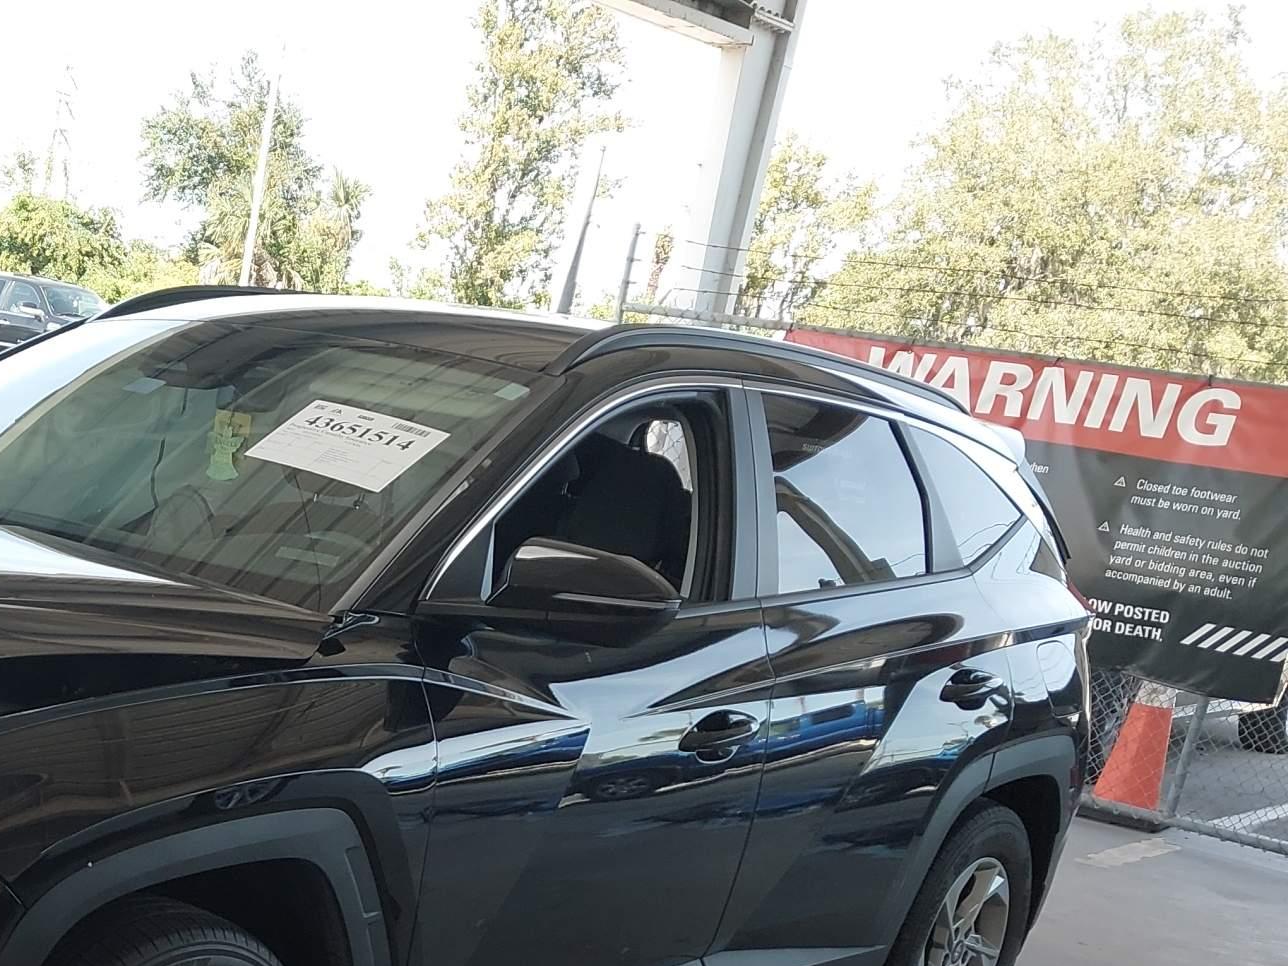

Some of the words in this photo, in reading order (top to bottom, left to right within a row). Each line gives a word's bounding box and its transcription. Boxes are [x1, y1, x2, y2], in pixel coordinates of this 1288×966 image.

[305, 416, 415, 450] 43651514
[1031, 462, 1049, 474] hen
[1136, 479, 1171, 494] Closed
[1172, 485, 1188, 496] toe
[1190, 487, 1238, 503] footwear
[1131, 495, 1156, 507] must
[1158, 498, 1170, 509] be
[1172, 502, 1199, 513] worn
[1201, 506, 1214, 516] on
[1216, 508, 1241, 520] yard.
[1119, 523, 1152, 538] Health
[1153, 531, 1173, 542] and
[1173, 534, 1206, 550] safety
[1206, 540, 1233, 552] rules
[1234, 543, 1248, 555] do
[1250, 547, 1269, 559] not
[1109, 555, 1133, 566] yard
[1134, 559, 1147, 569] or
[1148, 559, 1186, 577] bidding
[1189, 568, 1215, 582] area,
[1218, 574, 1245, 586] even
[1248, 577, 1258, 588] if
[1114, 540, 1146, 553] permit
[1147, 545, 1187, 560] children
[1189, 550, 1199, 562] in
[1202, 553, 1219, 565] the
[1222, 558, 1263, 574] auction
[1105, 569, 1171, 588] accompanied
[1173, 579, 1186, 593] by
[1188, 584, 1201, 594] an
[1203, 586, 1232, 600] adult.
[1114, 603, 1170, 624] POSTED
